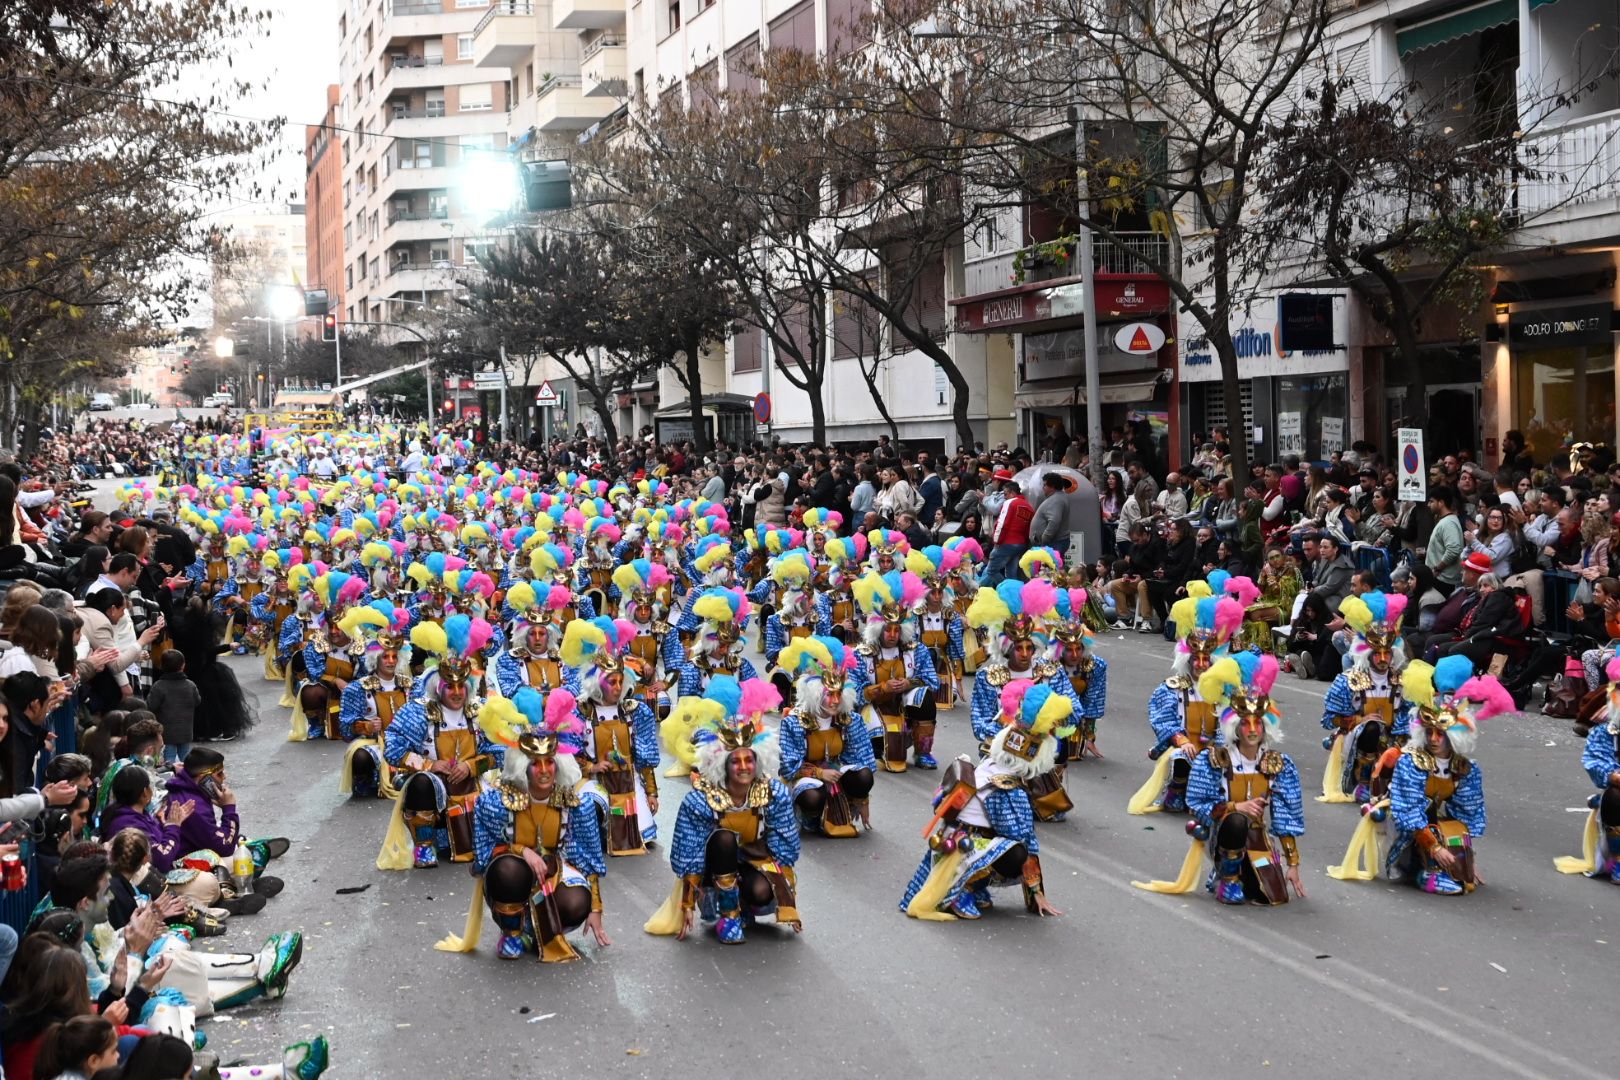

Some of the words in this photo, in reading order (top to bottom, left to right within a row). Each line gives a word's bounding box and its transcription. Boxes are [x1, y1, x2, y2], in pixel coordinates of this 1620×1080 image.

[988, 297, 1023, 322] GENERALI
[1523, 322, 1551, 336] ADOLFO
[1554, 317, 1599, 334] DONGUEZ
[1232, 327, 1272, 358] difon
